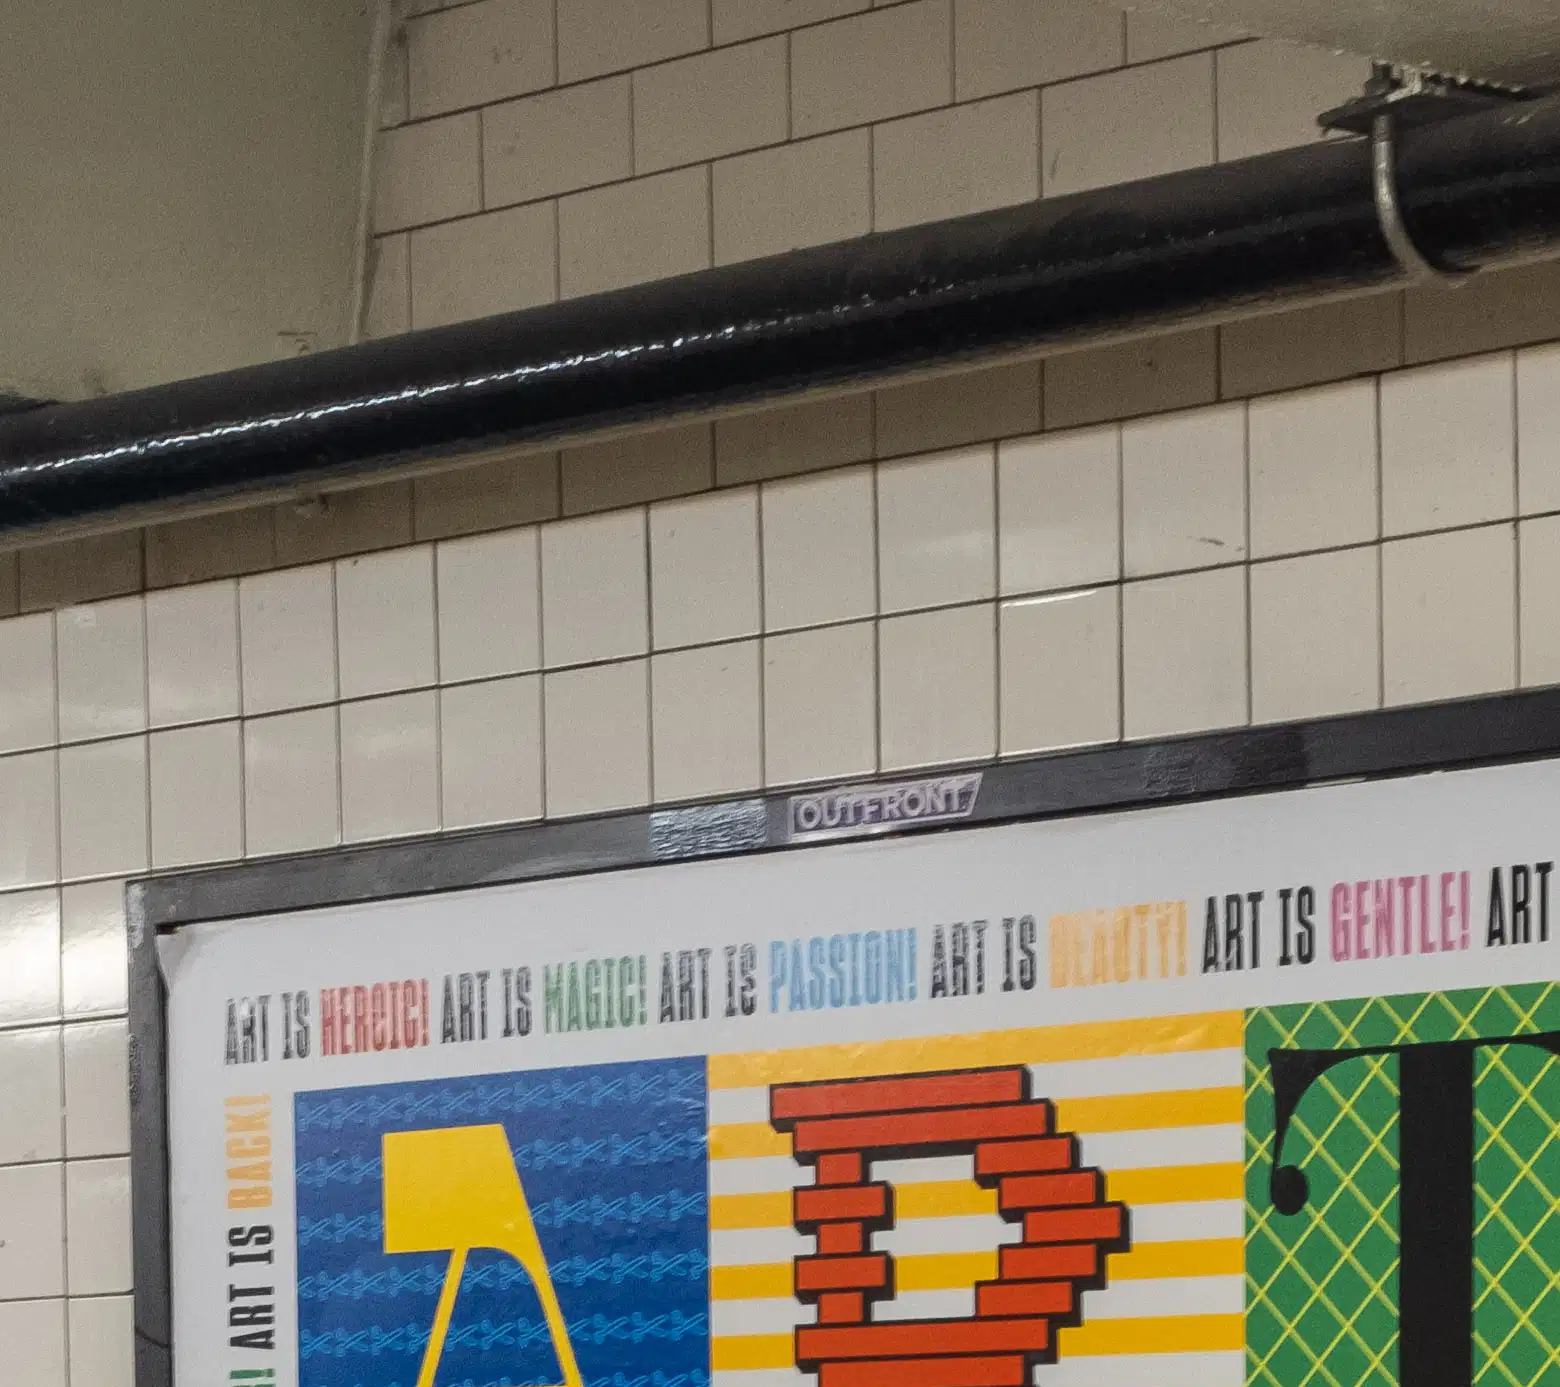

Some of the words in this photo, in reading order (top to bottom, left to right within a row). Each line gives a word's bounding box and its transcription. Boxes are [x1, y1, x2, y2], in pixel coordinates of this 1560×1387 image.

[794, 784, 966, 830] OUTFRONT
[224, 995, 270, 1065] ART
[282, 990, 311, 1061] IS
[319, 978, 430, 1057] HEROIC!
[440, 970, 489, 1044] ART
[500, 966, 533, 1038] IS
[543, 954, 649, 1035] MAGIC!
[657, 947, 712, 1025] ART
[723, 943, 757, 1017] IS
[768, 927, 917, 1014] PASSION!
[929, 919, 988, 999] ART
[999, 914, 1037, 992] IS
[1049, 900, 1187, 989] BEAUTY!
[1201, 890, 1264, 974] ART
[1277, 886, 1316, 967] IS
[1329, 871, 1470, 962] GENTLE!
[1484, 861, 1553, 947] ART
[225, 1093, 273, 1209] BACK!
[228, 1225, 274, 1267] IS
[228, 1284, 275, 1350] ART
